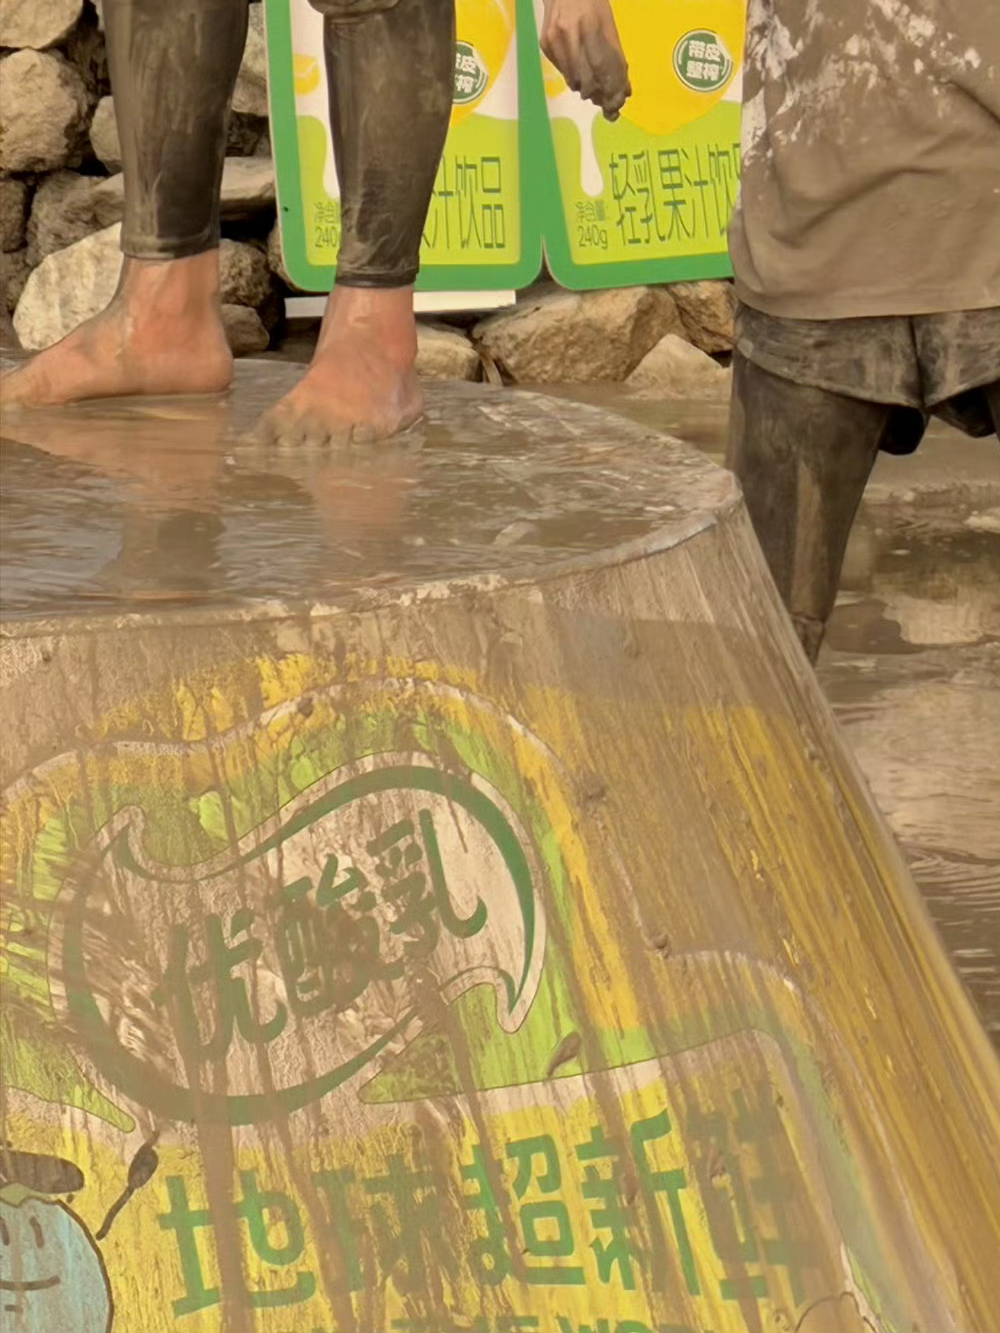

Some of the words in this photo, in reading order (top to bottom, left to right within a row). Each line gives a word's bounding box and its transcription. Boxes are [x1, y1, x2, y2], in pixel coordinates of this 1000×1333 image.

[609, 142, 741, 247] 轻乳果汁饮
[576, 223, 609, 251] 240g
